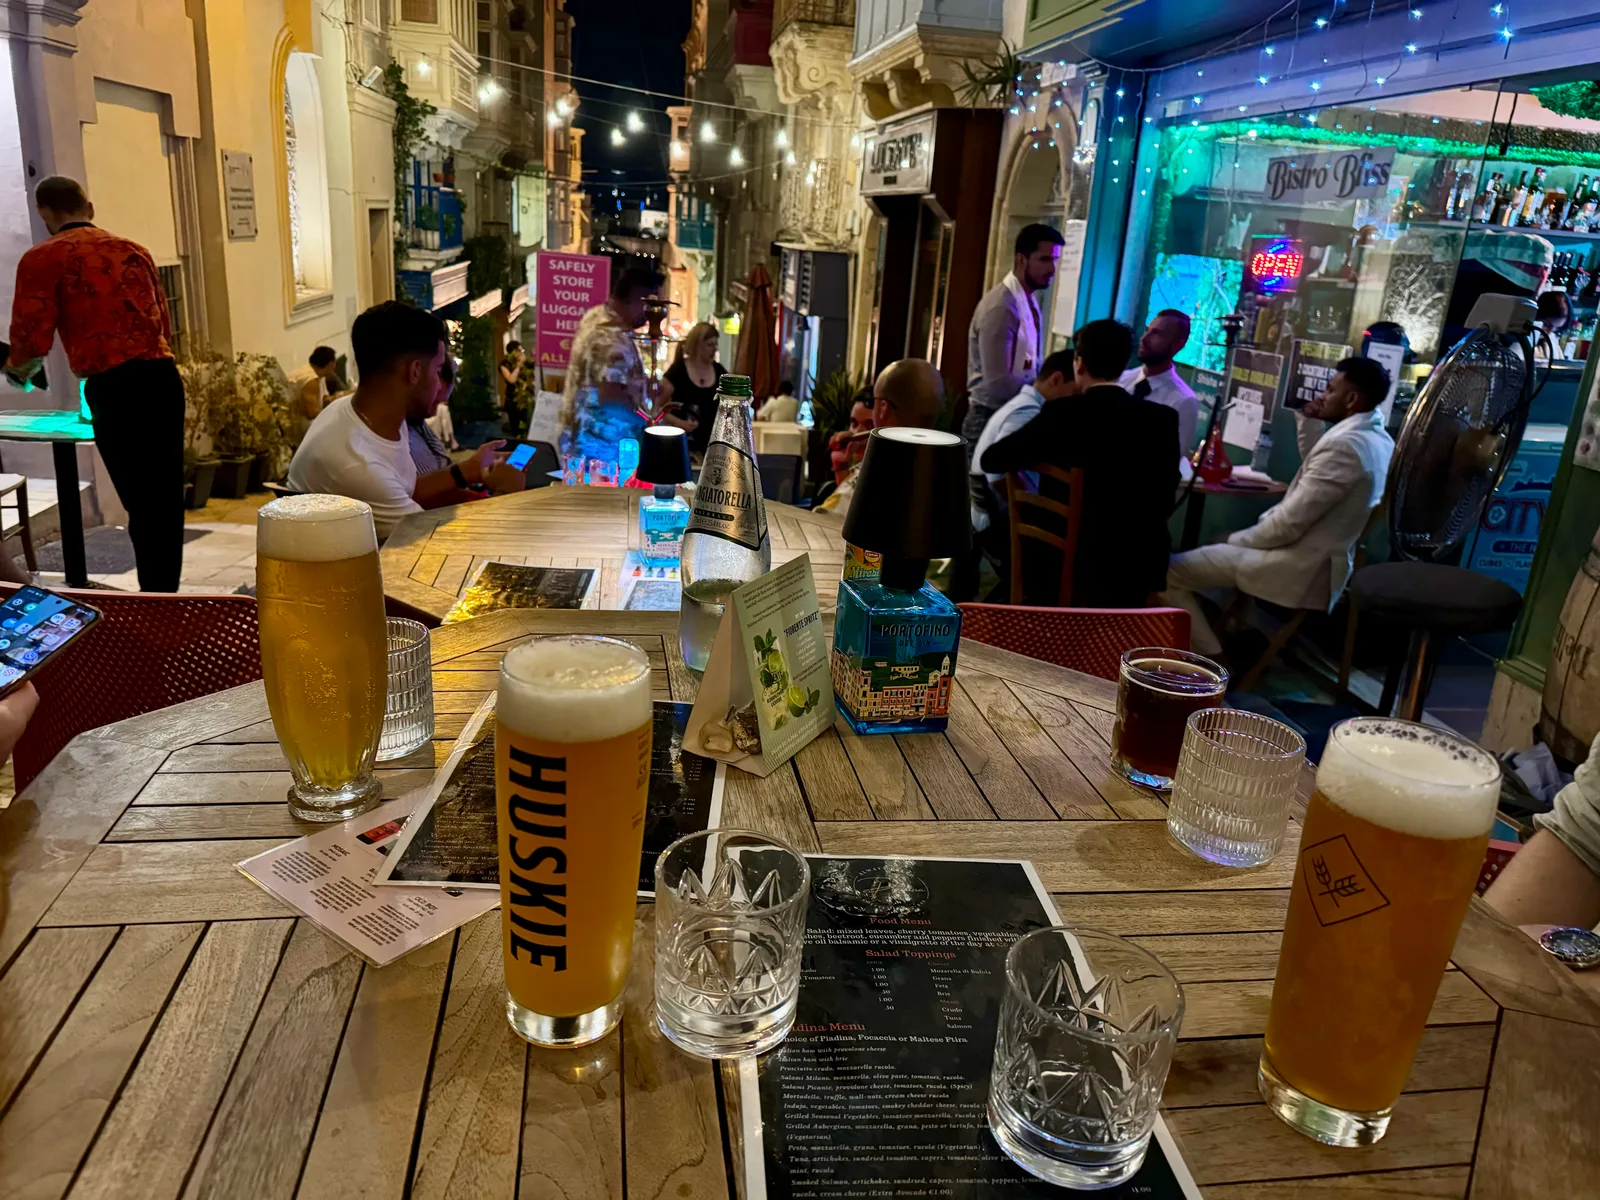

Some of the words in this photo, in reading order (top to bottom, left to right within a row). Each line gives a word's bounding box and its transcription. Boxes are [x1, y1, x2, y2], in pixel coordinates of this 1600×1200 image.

[1266, 160, 1328, 200] Bistro
[1334, 152, 1391, 198] Bliss
[548, 259, 595, 274] SAFELY
[1252, 253, 1303, 278] OPEN
[552, 274, 594, 288] STORE
[553, 290, 590, 303] YOUR
[542, 304, 586, 316] LUGGA
[556, 320, 578, 331] HE
[541, 352, 566, 363] ALL
[880, 624, 950, 637] PORTOFINO
[508, 744, 568, 972] HUSKIE
[900, 918, 932, 926] Menu
[898, 928, 926, 936] cherry
[865, 949, 900, 957] Salad
[901, 950, 956, 960] Toppings
[829, 1022, 866, 1031] Menu
[950, 1083, 973, 1091] (Spicy)
[811, 1166, 835, 1174] rucola
[868, 1189, 893, 1197] (Extra
